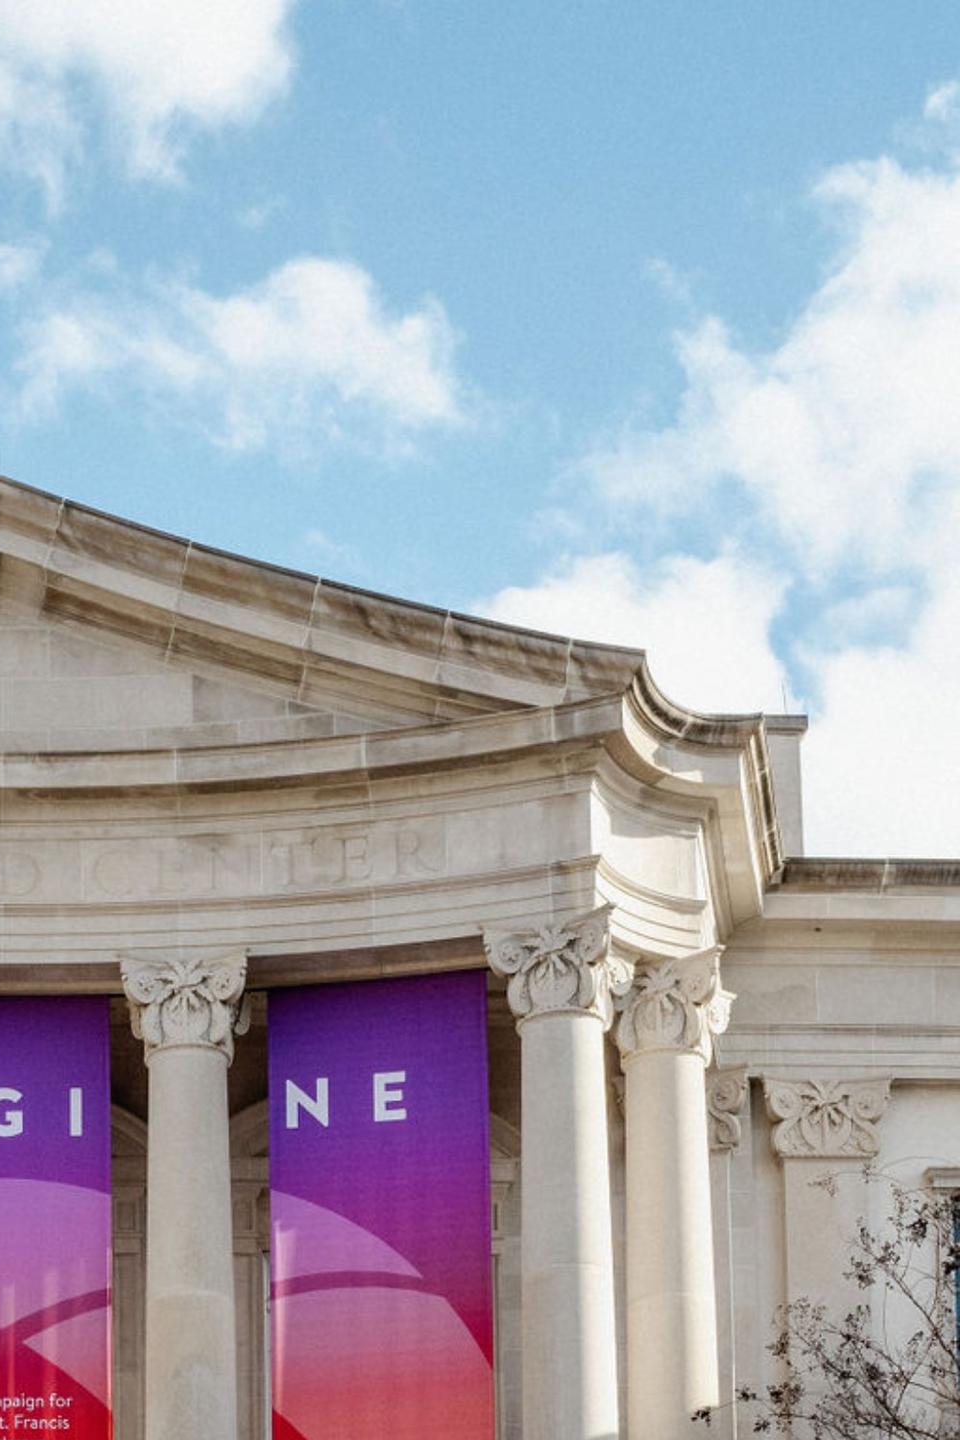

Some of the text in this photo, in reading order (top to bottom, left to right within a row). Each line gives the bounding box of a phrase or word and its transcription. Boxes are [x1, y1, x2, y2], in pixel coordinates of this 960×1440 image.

[93, 830, 442, 896] CENTER
[50, 1392, 73, 1408] for
[14, 1415, 70, 1430] Francis
